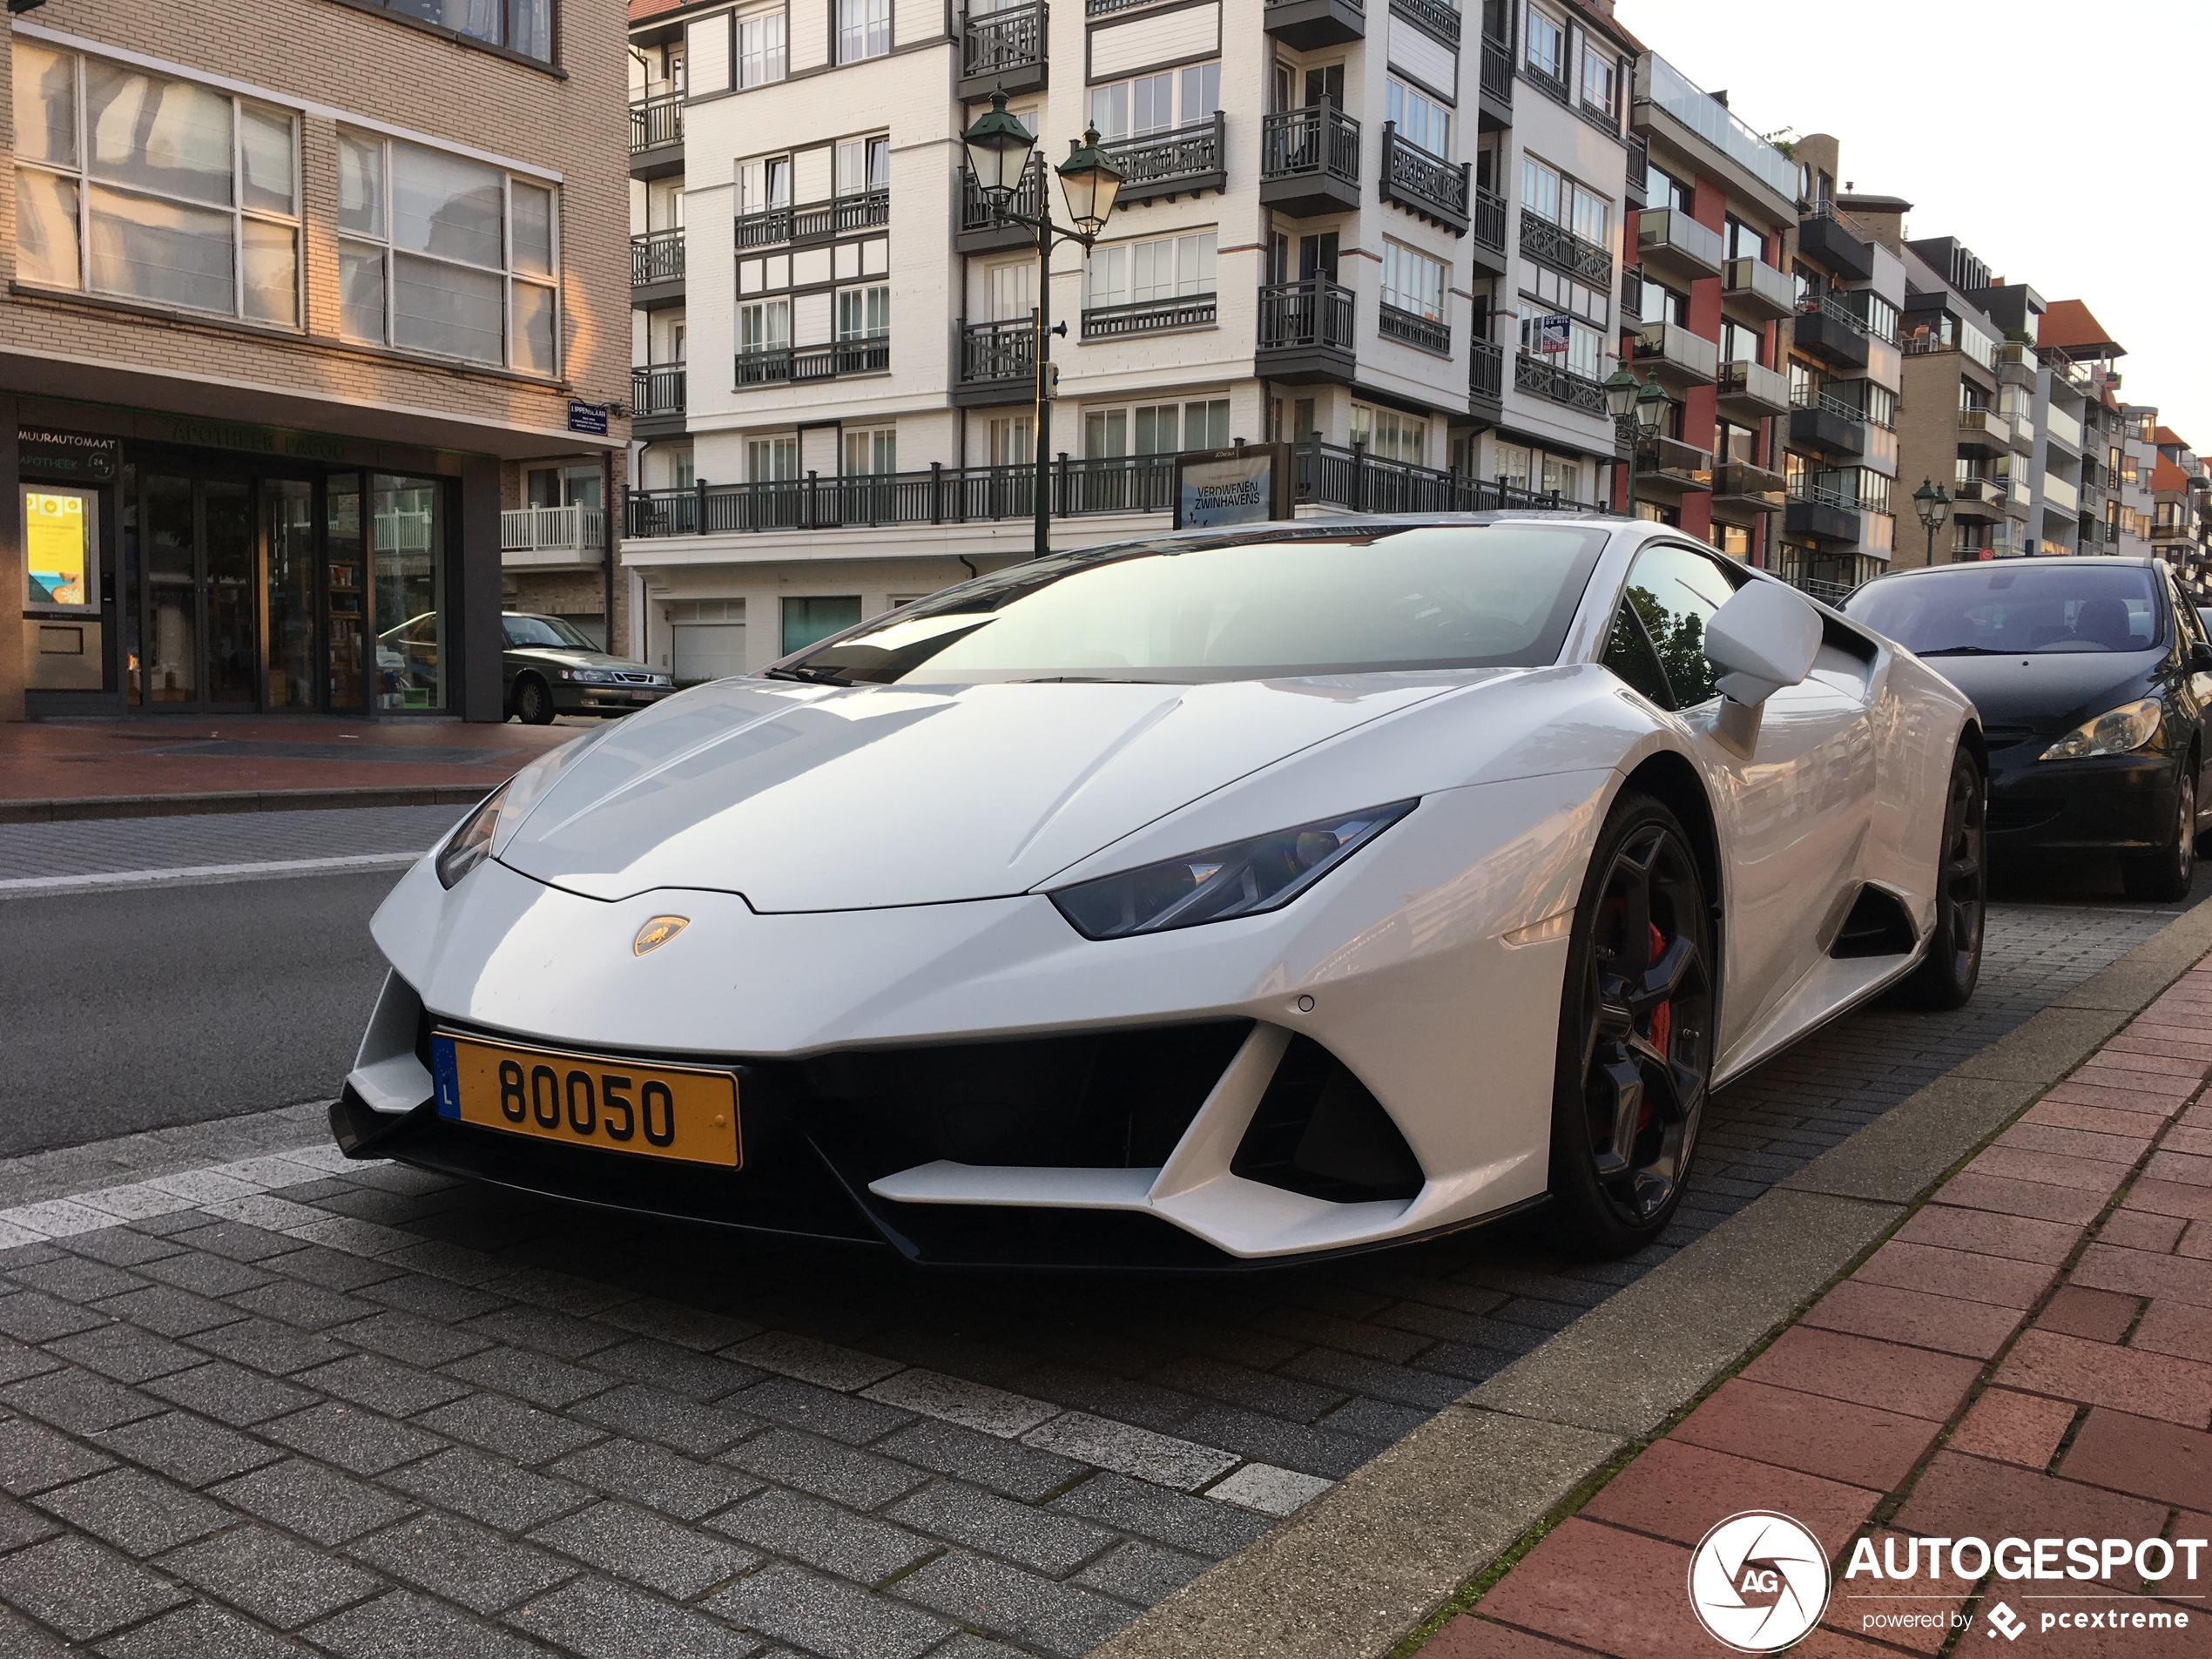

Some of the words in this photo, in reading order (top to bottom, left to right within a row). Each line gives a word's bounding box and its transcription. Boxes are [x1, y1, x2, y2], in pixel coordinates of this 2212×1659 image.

[571, 406, 606, 417] LIPPENSLAAN
[17, 430, 115, 450] MUURAUTOMAAT
[19, 455, 78, 470] APOTHEEK
[1197, 481, 1258, 497] VERDWENEN
[1195, 492, 1260, 510] ZWINHAVENS
[442, 1084, 453, 1106] L
[499, 1059, 676, 1148] 80050
